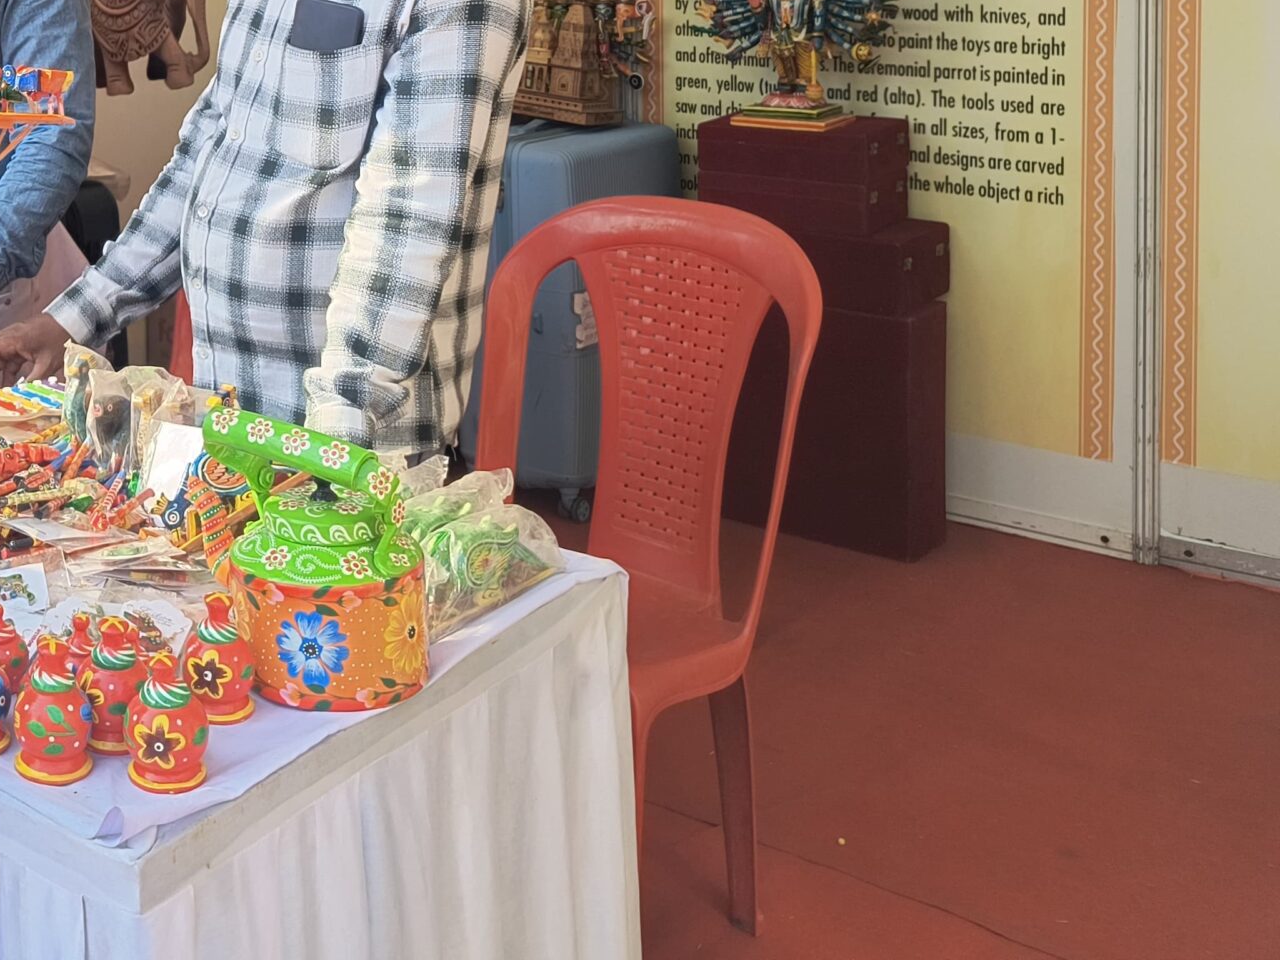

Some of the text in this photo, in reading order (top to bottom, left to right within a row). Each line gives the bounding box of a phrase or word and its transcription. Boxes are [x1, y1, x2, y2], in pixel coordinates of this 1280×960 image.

[902, 3, 1066, 28] wood with knives, and
[675, 75, 1065, 116] green, yellow and red (alta). The tools used are
[934, 146, 1064, 176] designs are carved
[910, 173, 1064, 205] the whole object a rich
